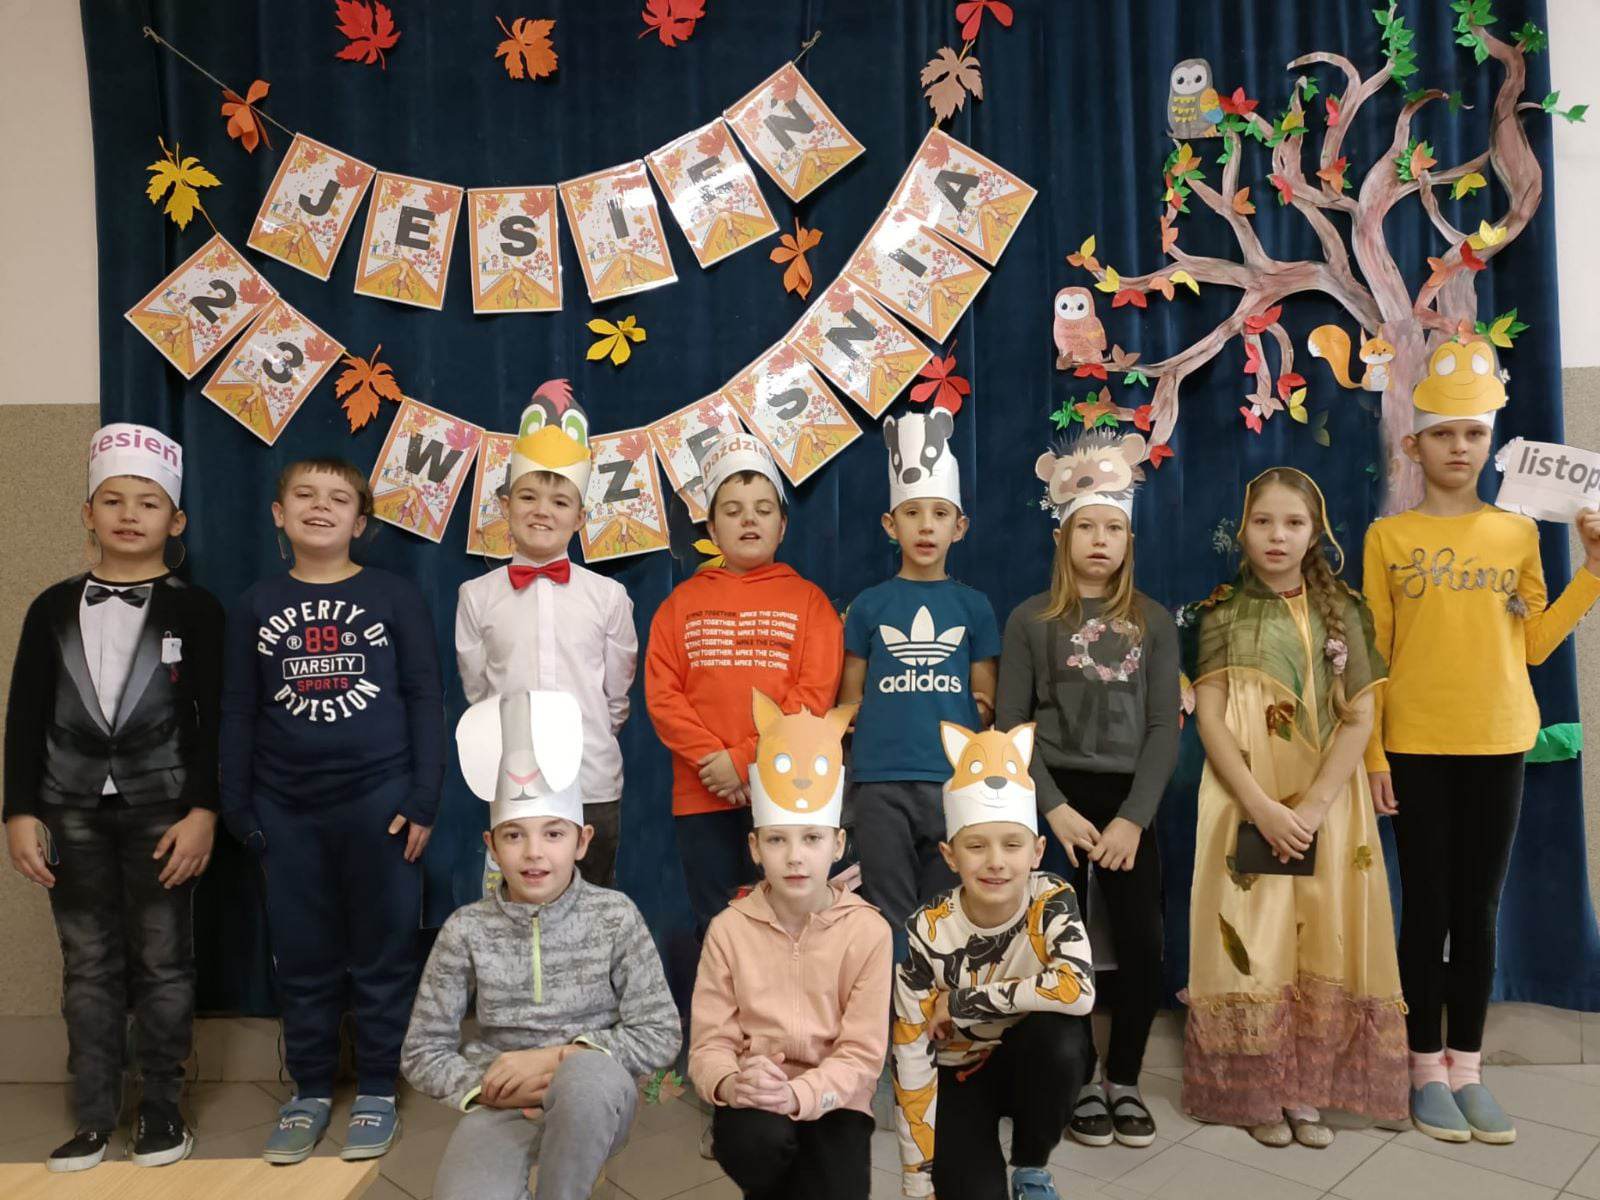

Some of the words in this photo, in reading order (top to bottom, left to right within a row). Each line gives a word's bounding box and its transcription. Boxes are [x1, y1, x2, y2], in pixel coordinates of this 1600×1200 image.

[189, 279, 304, 385] 23
[1518, 446, 1600, 493] listop
[257, 599, 366, 656] PROPERTY
[363, 622, 389, 647] OF
[305, 625, 338, 653] 89
[289, 657, 356, 676] VARSITY
[879, 669, 962, 693] adidas
[274, 678, 381, 722] DIVISION
[296, 677, 350, 693] SPORTS
